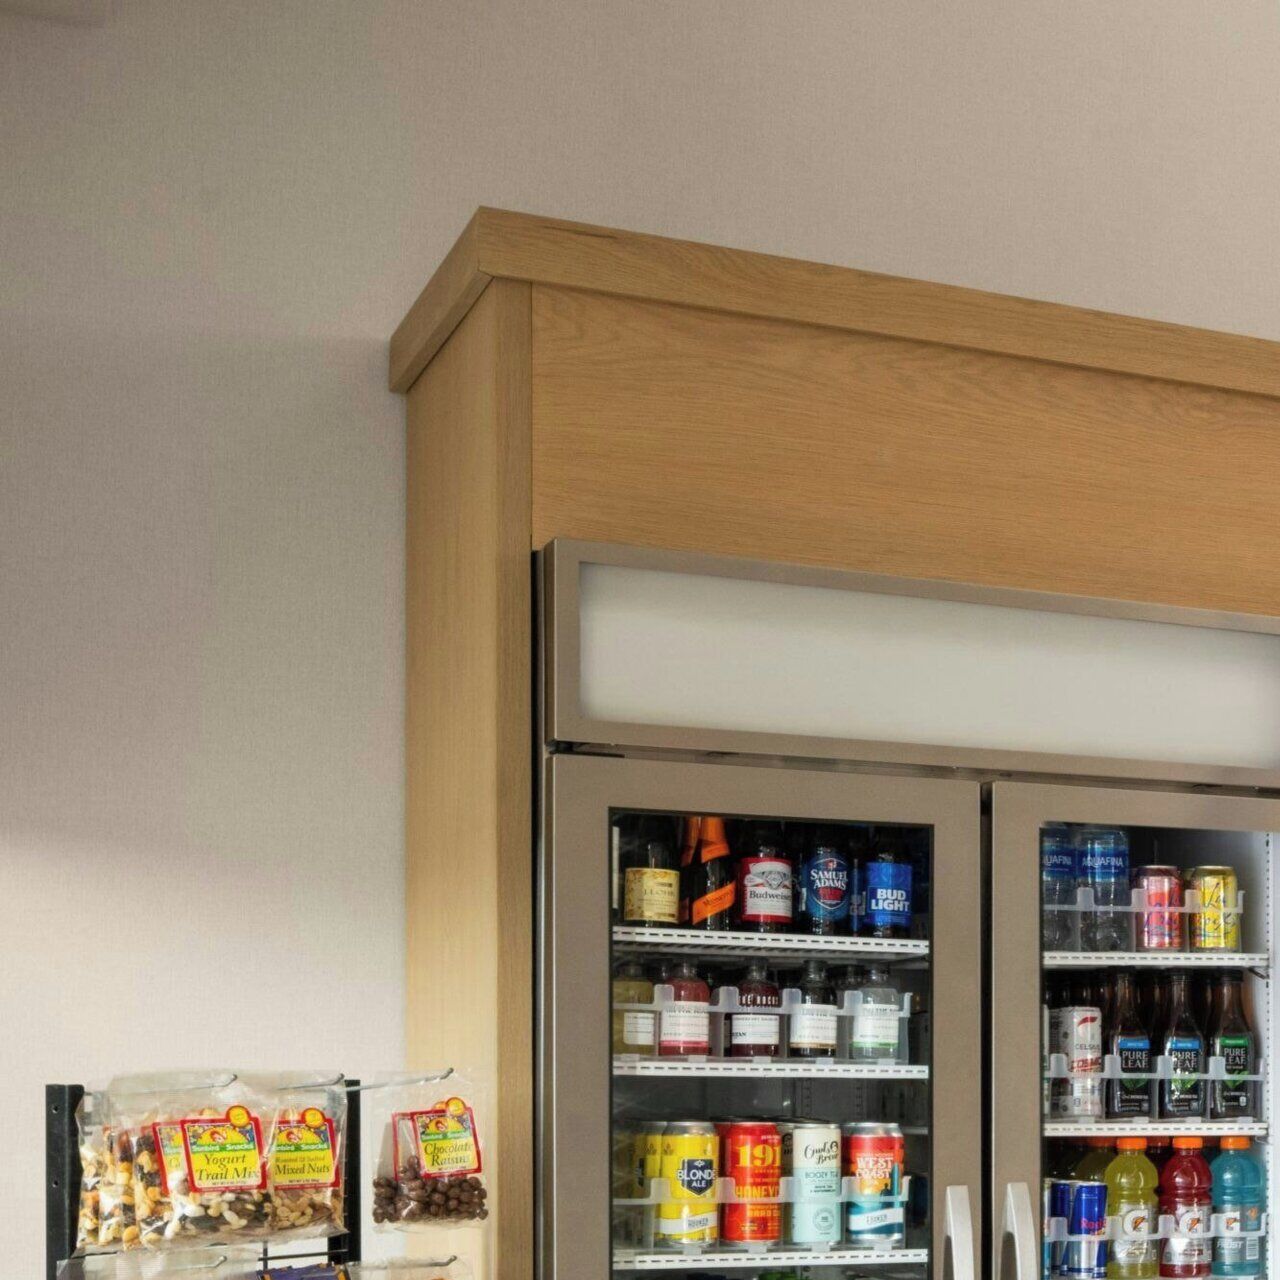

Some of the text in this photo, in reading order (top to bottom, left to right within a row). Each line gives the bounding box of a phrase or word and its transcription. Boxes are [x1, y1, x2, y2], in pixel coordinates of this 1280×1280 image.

[1082, 855, 1124, 868] AQUAFINA
[810, 868, 848, 880] SAMUEL
[814, 879, 847, 890] ADAMS
[877, 888, 906, 900] BUD
[871, 899, 911, 911] LIGHT
[1122, 1051, 1149, 1060] PURE
[1223, 1048, 1246, 1057] PURE
[204, 1153, 246, 1170] Yogurt
[856, 1156, 894, 1169] WEST
[199, 1167, 229, 1181] Trail
[274, 1162, 330, 1176] Mixed Nuts
[691, 1180, 706, 1188] ALE
